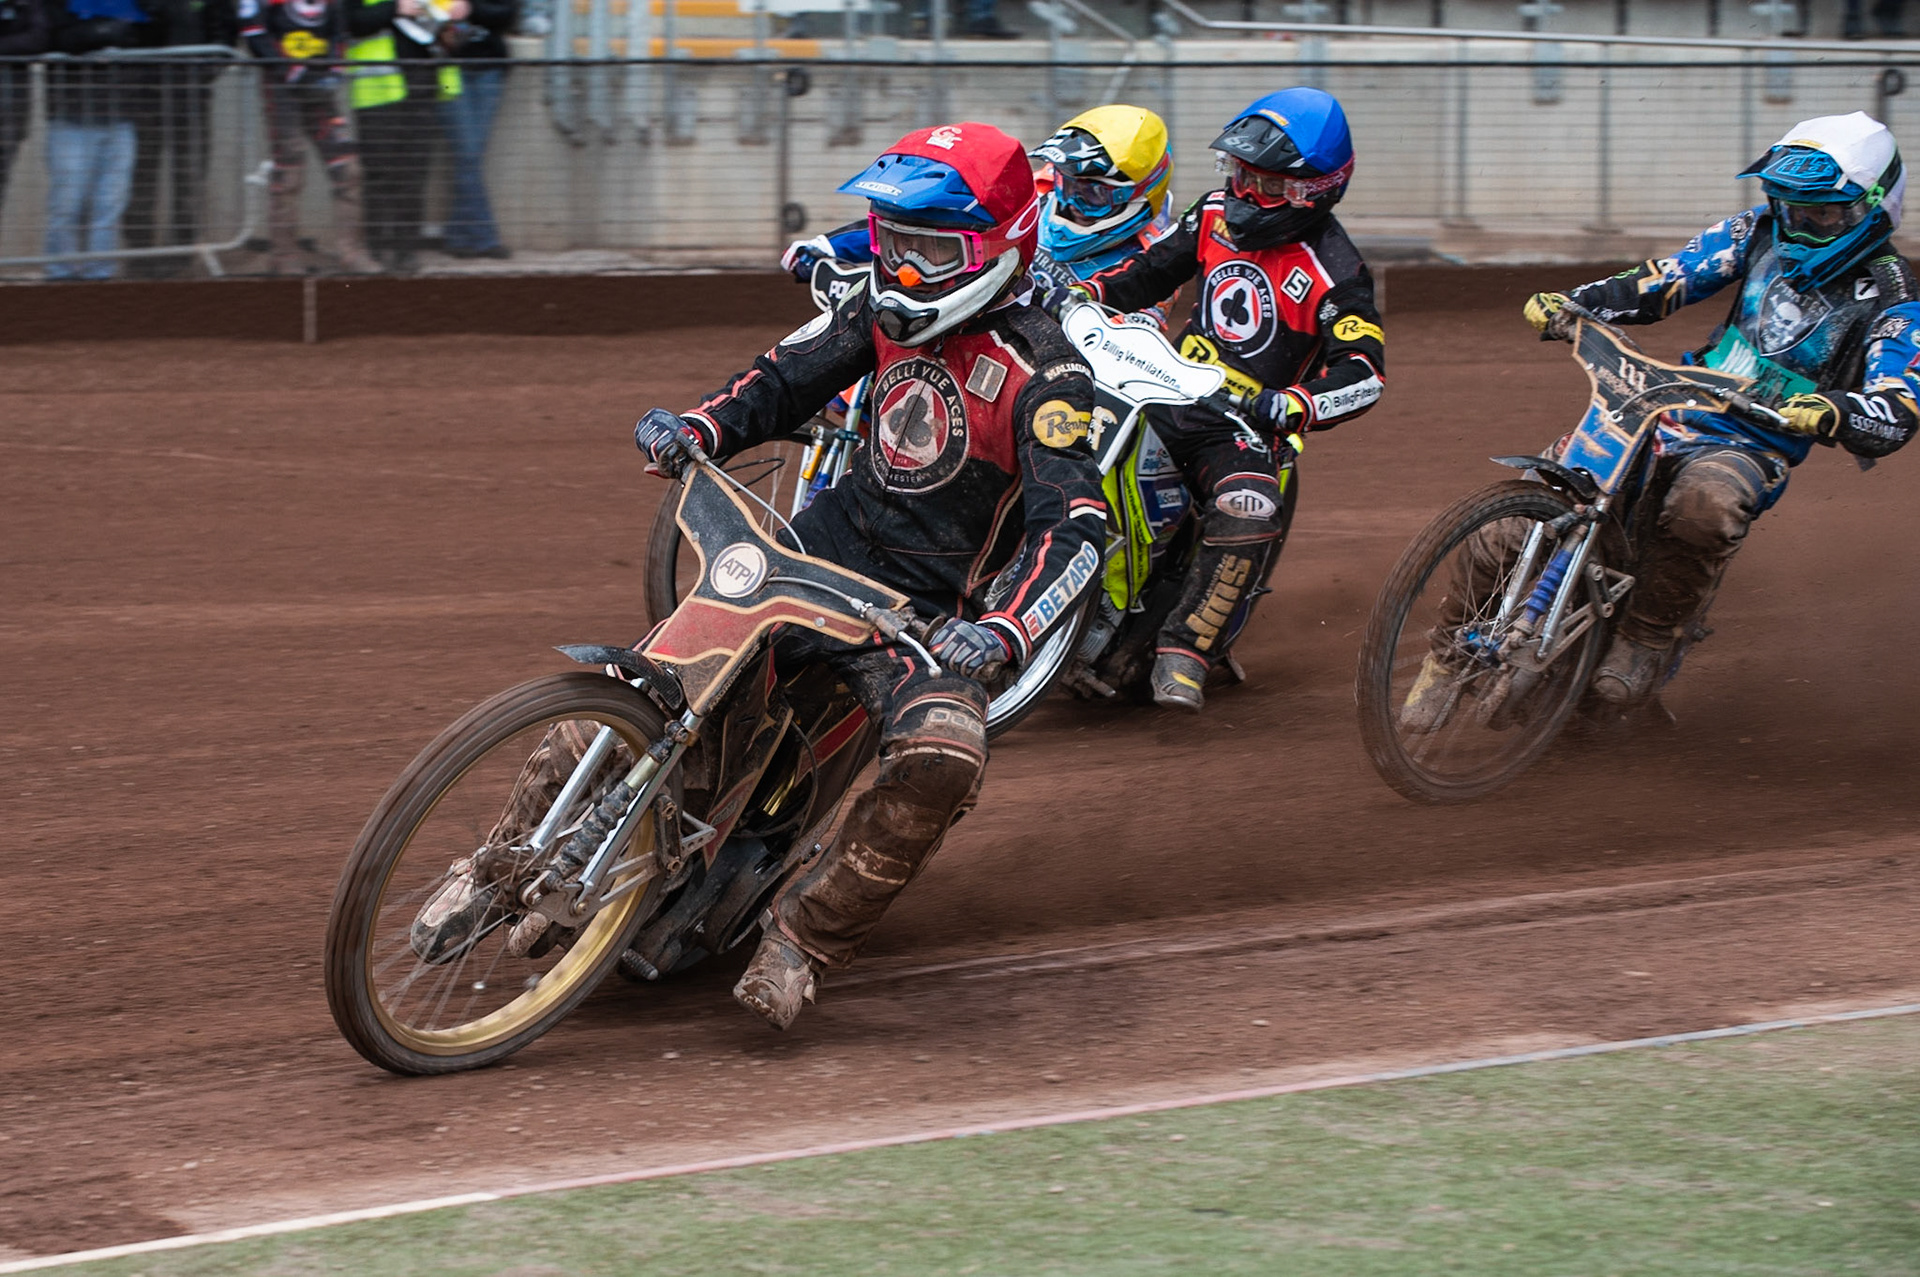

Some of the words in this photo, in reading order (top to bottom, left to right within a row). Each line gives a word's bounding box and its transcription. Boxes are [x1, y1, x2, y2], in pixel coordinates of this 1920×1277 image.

[1210, 266, 1240, 287] BELLE
[1258, 287, 1273, 318] ACES
[1291, 274, 1308, 295] 5
[1859, 280, 1877, 296] 7
[882, 364, 917, 392] BELLE
[922, 366, 950, 390] VUE
[946, 395, 964, 437] ACES
[719, 557, 755, 586] ATPI
[1038, 543, 1099, 623] BETARD
